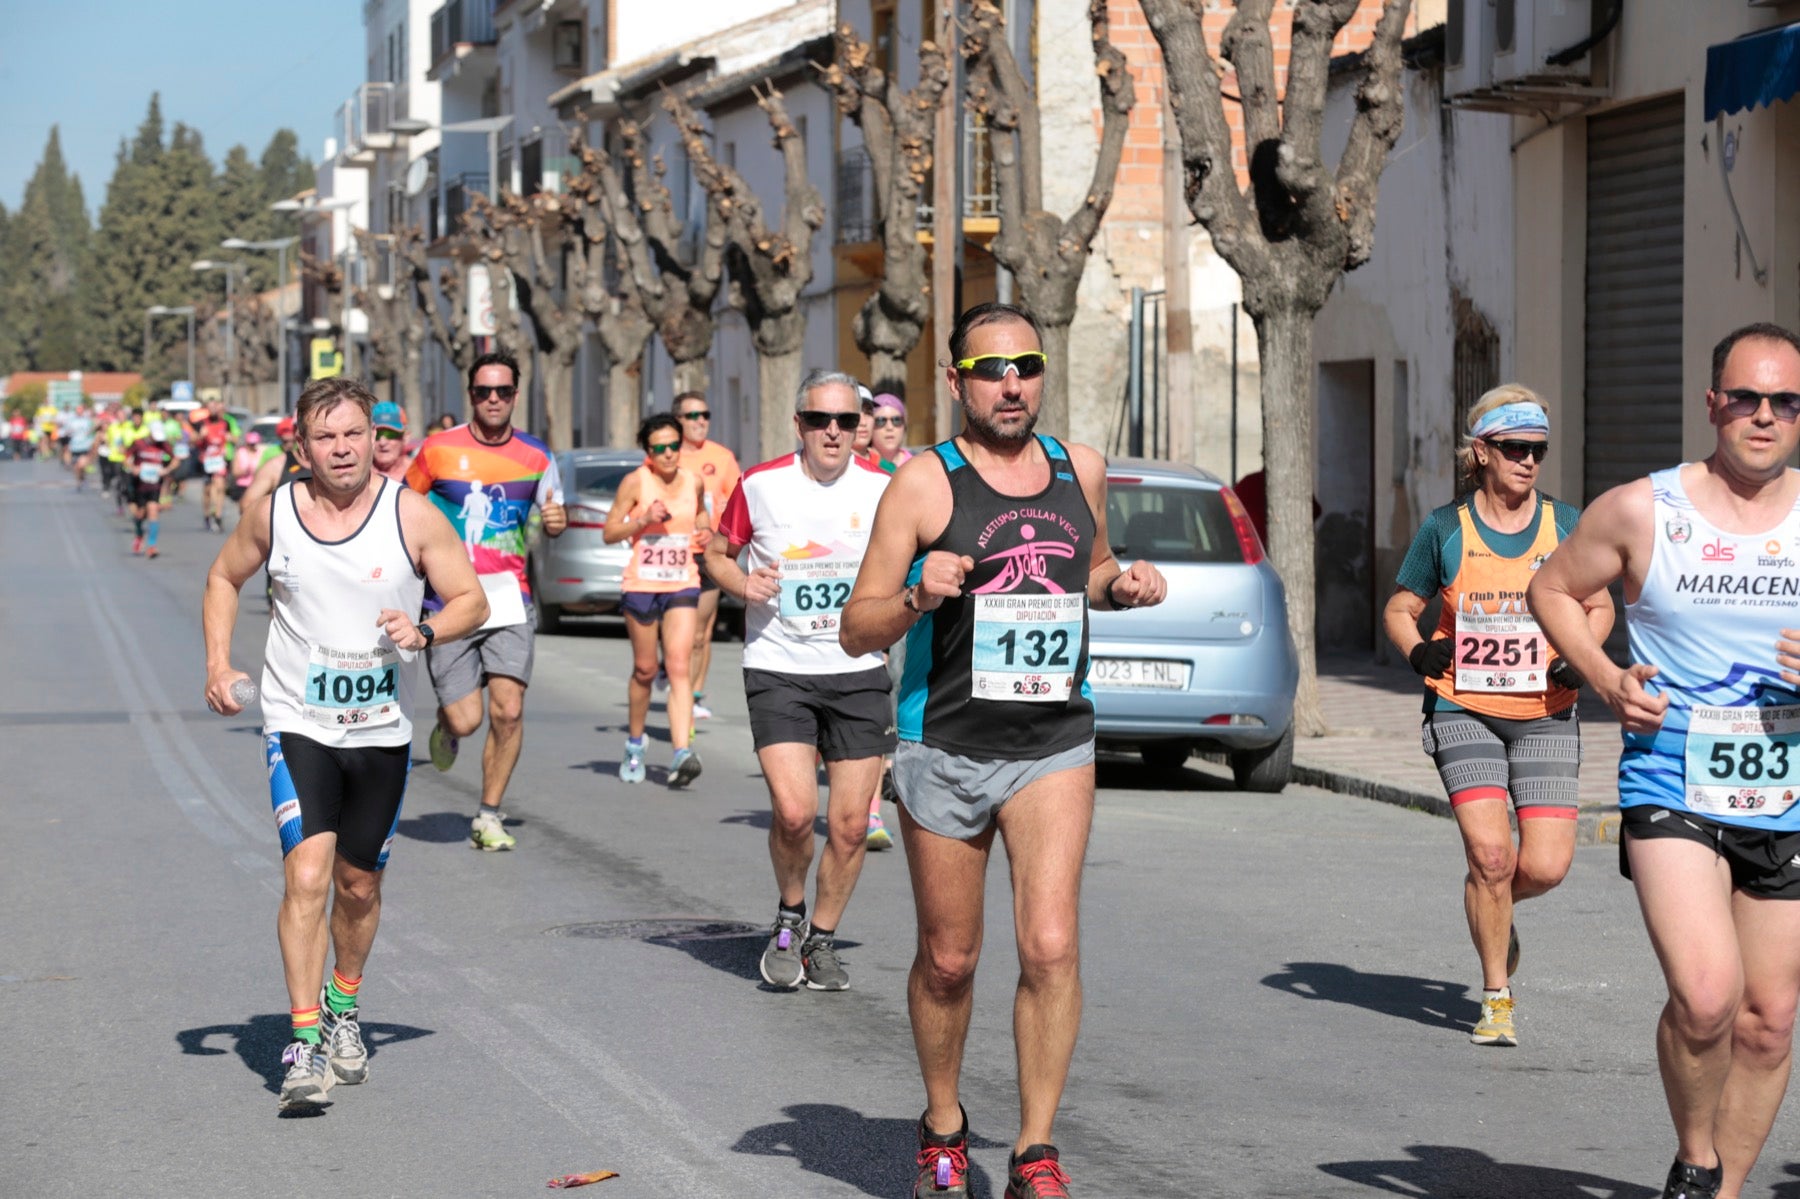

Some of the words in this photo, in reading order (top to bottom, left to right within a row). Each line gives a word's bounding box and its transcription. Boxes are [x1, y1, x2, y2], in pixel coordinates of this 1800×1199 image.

[977, 510, 1018, 549] ATLETISMO
[1020, 508, 1056, 522] CULLAR
[1059, 516, 1080, 543] VEGA
[643, 549, 687, 565] 2133
[800, 562, 813, 571] GRAN
[815, 561, 833, 570] PREMIO
[834, 561, 841, 569] DE
[1676, 574, 1800, 597] MARACEN
[795, 582, 851, 611] 632
[984, 598, 1005, 608] XXXIII
[1007, 598, 1026, 608] GRAN
[1028, 598, 1052, 608] PREMIO
[1054, 599, 1062, 608] DE
[1063, 598, 1079, 608] FONDO
[1469, 591, 1494, 602] Club
[1498, 590, 1526, 601] Dep
[1693, 597, 1721, 606] CLUB
[1724, 598, 1738, 606] DE
[1740, 599, 1798, 608] ATLETISMO
[1522, 614, 1537, 623] FON
[347, 650, 369, 661] PREMIO
[997, 629, 1070, 667] 132
[1461, 637, 1538, 667] 2251
[1142, 661, 1177, 682] FNL
[313, 668, 395, 704] 1094
[1699, 708, 1720, 719] XXXIII
[1722, 709, 1742, 720] GRAN
[1745, 710, 1770, 721] PREMIO
[1772, 709, 1780, 720] DE
[1708, 741, 1789, 781] 583
